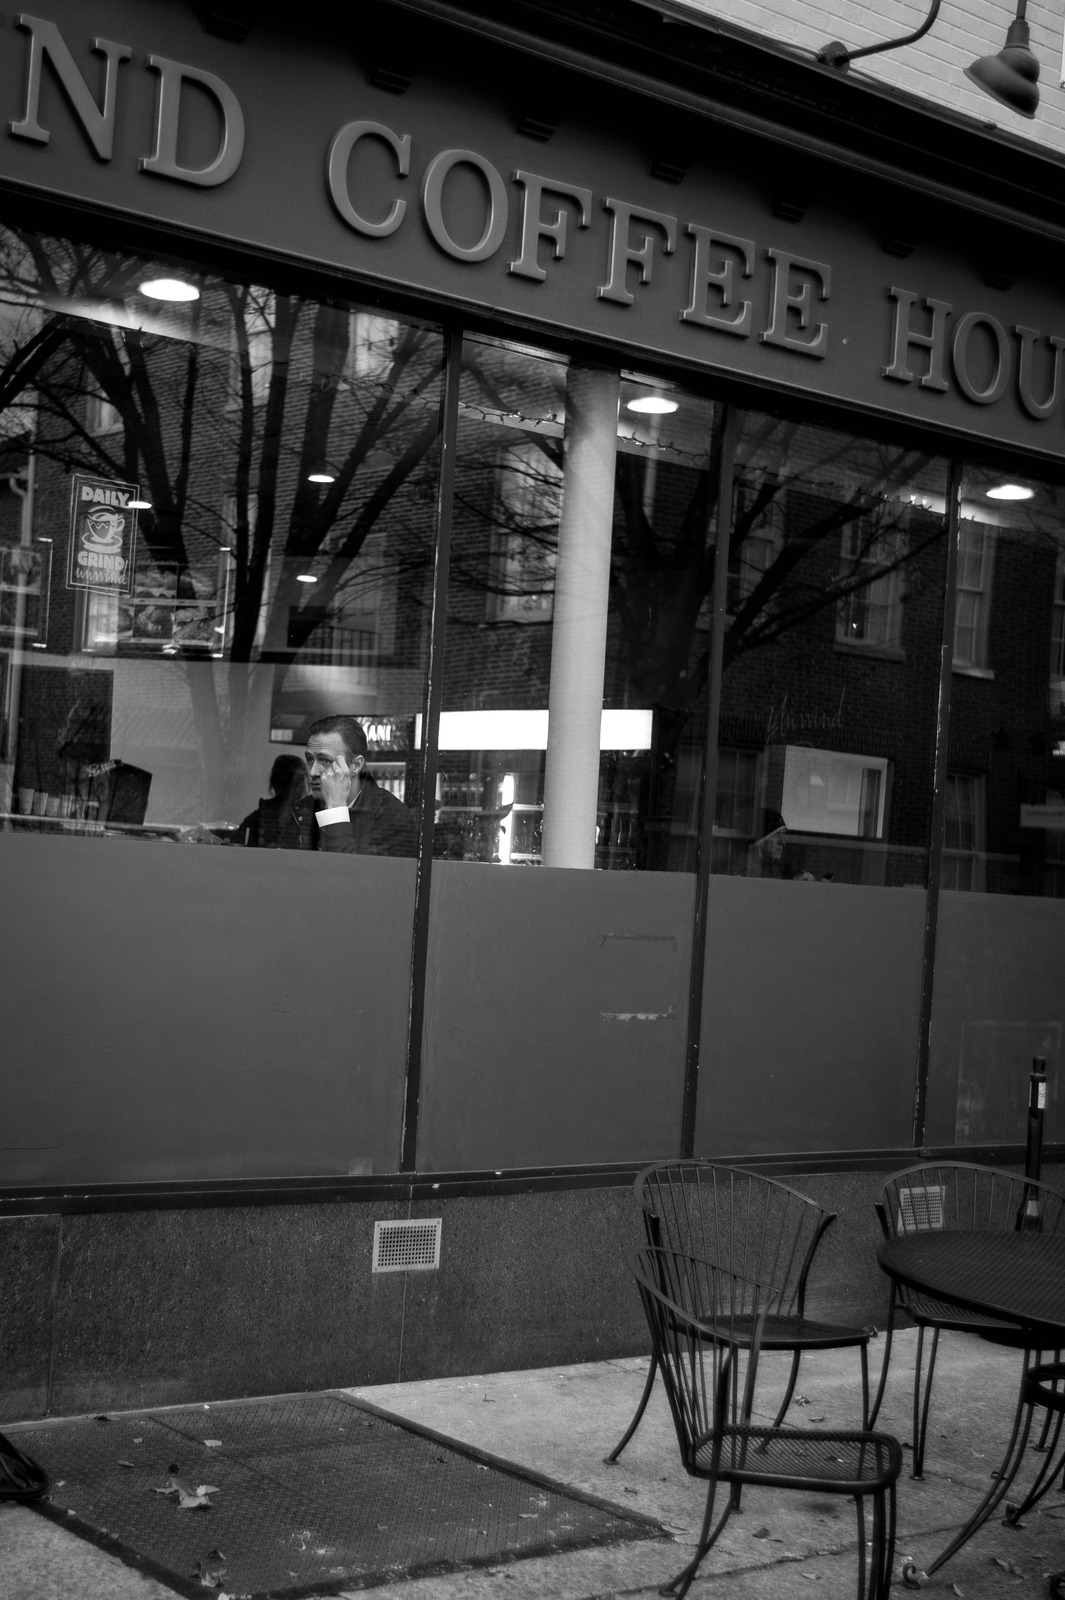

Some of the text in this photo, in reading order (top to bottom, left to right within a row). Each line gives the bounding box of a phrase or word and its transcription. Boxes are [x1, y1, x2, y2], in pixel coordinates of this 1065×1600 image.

[9, 13, 1065, 419] ND COFFEE HOU
[82, 486, 130, 507] DAILY
[77, 551, 126, 571] GRIND
